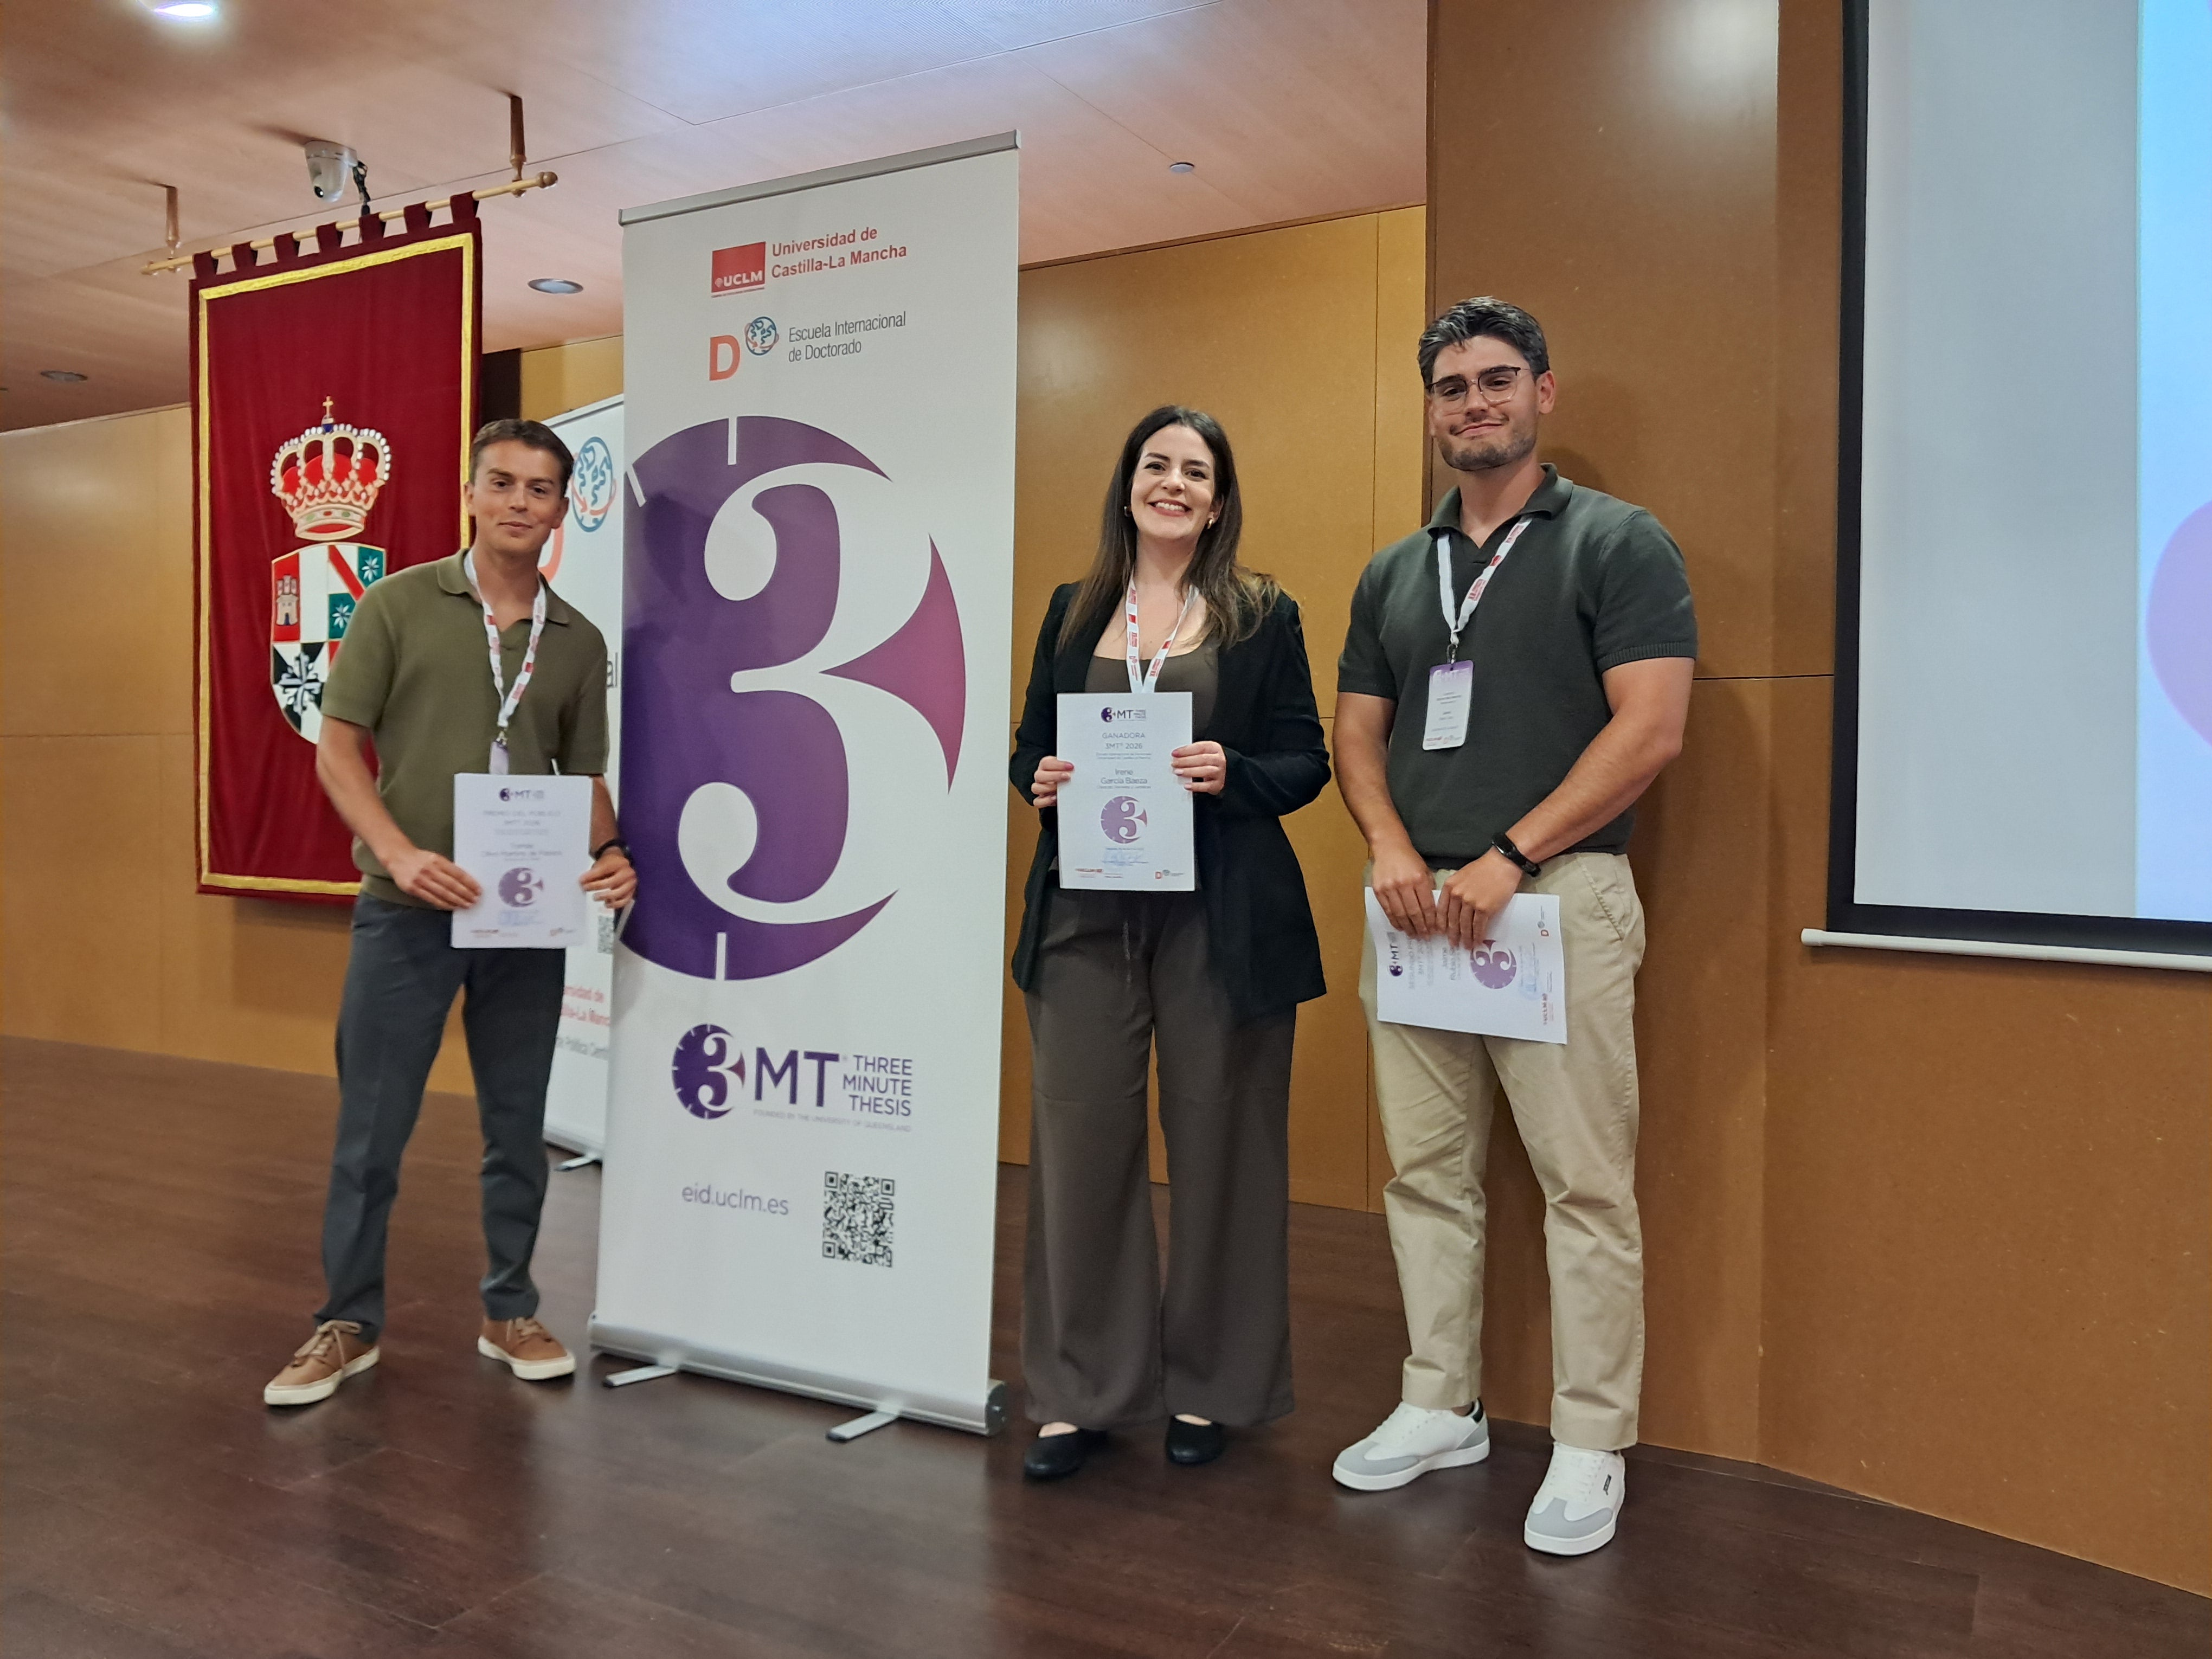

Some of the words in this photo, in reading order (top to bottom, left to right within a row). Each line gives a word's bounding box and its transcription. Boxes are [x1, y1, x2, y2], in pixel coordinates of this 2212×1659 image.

[771, 229, 856, 257] Universidad
[860, 227, 878, 242] de
[771, 254, 846, 278] Castilla-La
[850, 244, 907, 266] Mancha
[723, 269, 763, 287] UCLM
[788, 323, 831, 343] Escuela
[835, 311, 906, 336] Internacional
[709, 334, 741, 381] D
[788, 348, 801, 362] de
[805, 339, 862, 361] Doctorado
[853, 1054, 912, 1076] THREE
[843, 1074, 912, 1096] MINUTE
[848, 1095, 911, 1116] THESIS
[681, 1182, 789, 1216] eid.uclm.es
